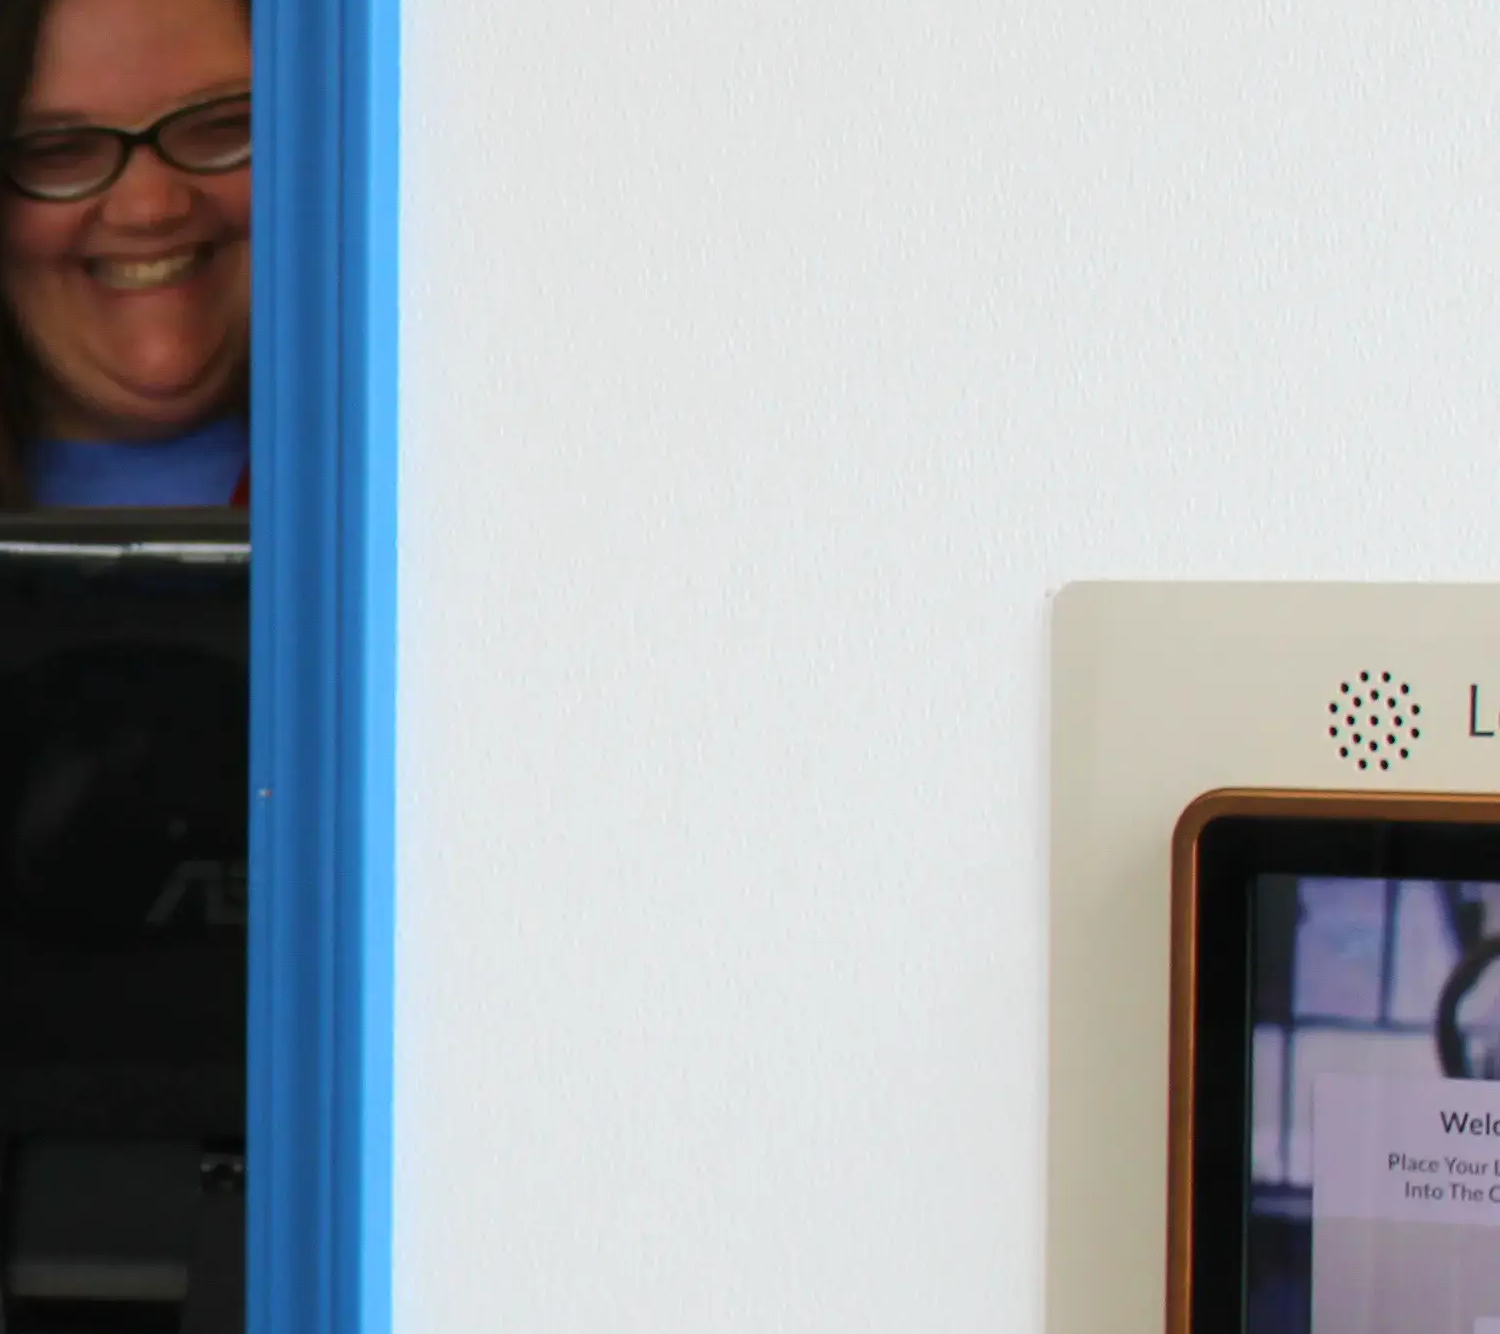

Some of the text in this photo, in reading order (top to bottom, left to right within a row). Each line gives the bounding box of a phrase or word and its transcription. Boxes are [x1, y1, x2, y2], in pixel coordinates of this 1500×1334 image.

[1469, 683, 1500, 737] L
[1388, 1152, 1439, 1173] Place
[1444, 1157, 1488, 1175] Your
[1405, 1181, 1444, 1200] Into
[1449, 1182, 1484, 1202] The
